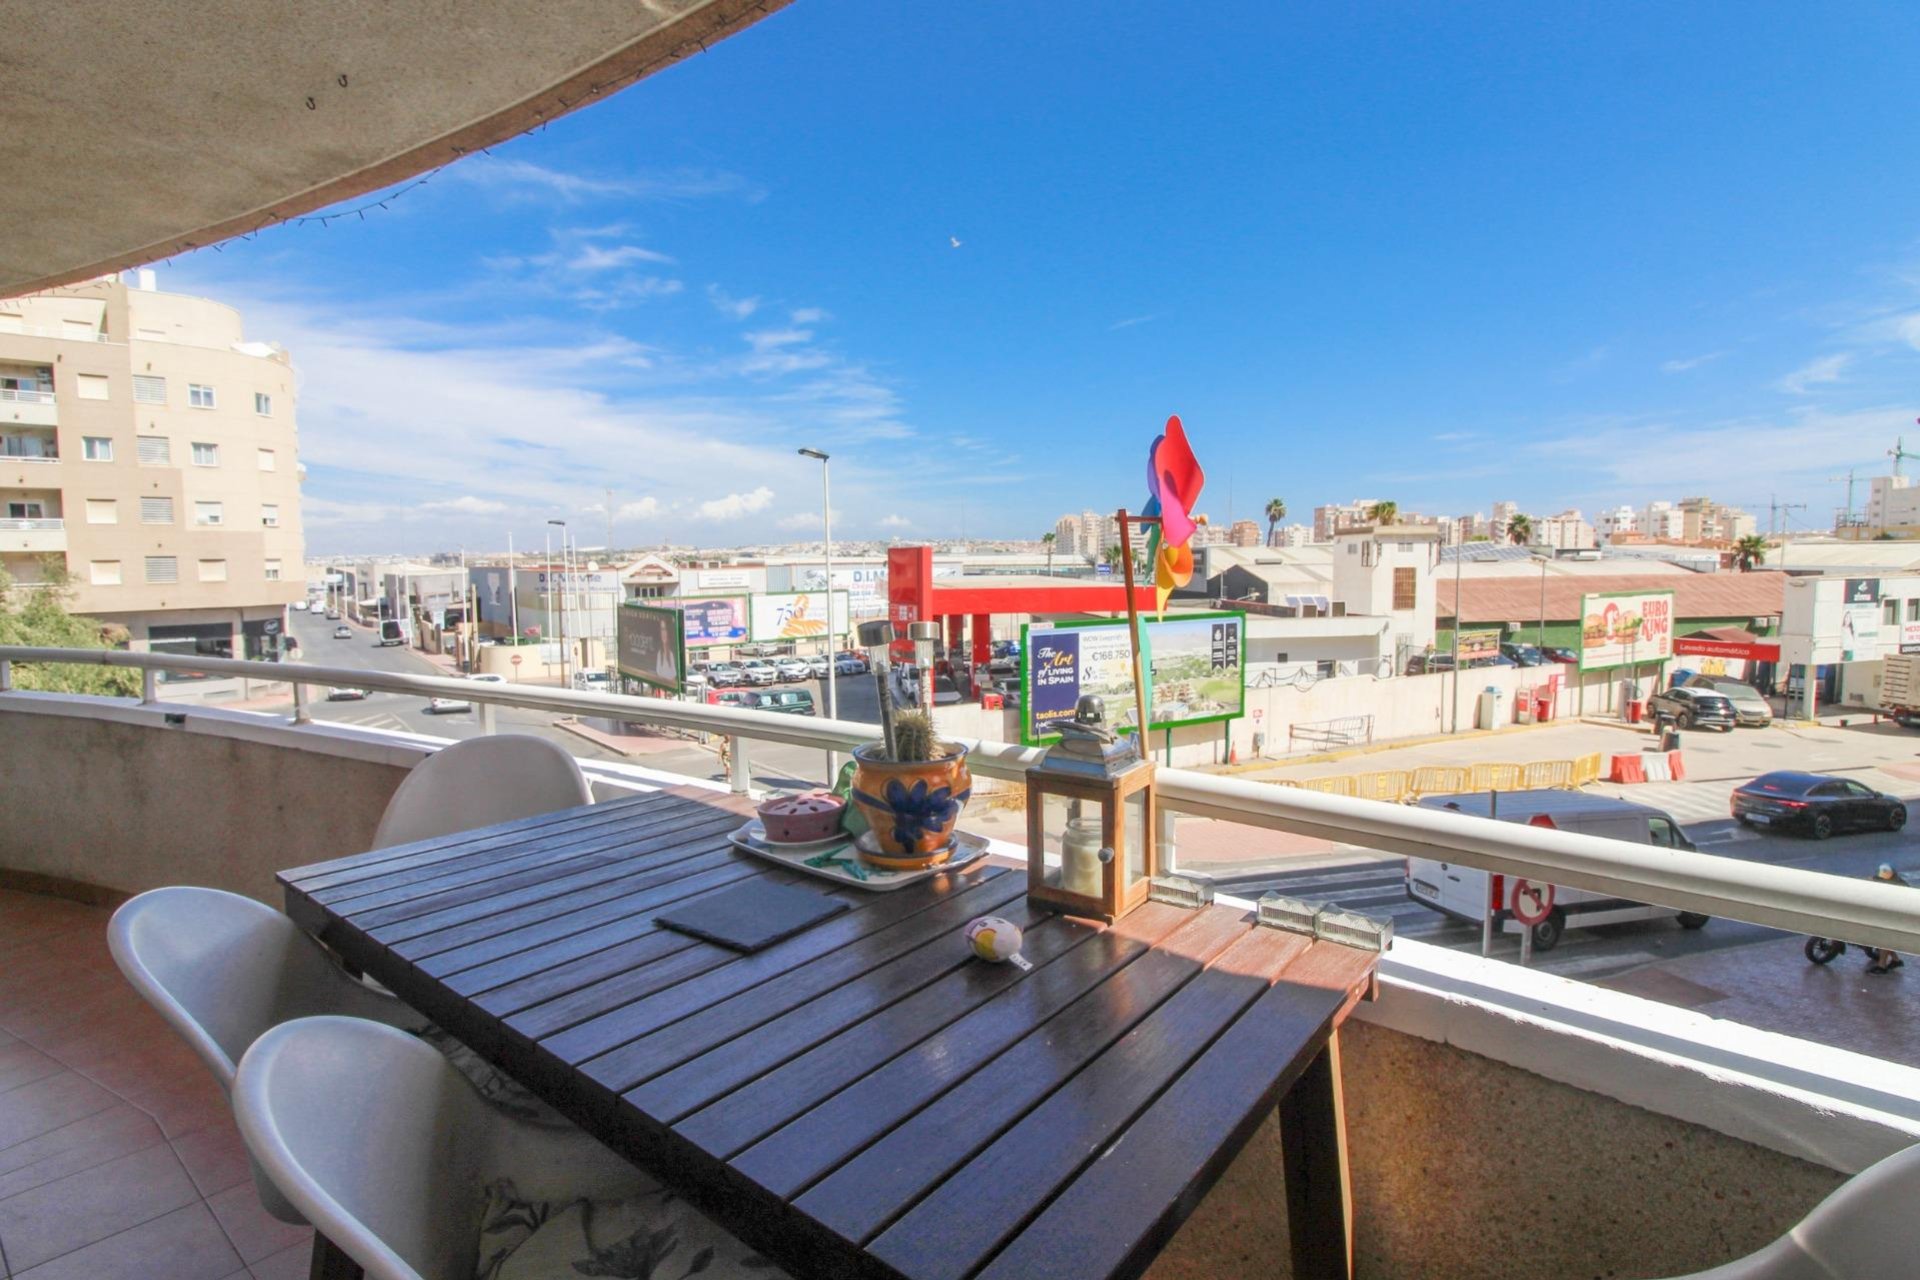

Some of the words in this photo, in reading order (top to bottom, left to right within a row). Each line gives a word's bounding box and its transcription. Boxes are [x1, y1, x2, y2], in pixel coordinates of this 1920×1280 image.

[1642, 600, 1668, 618] EURO
[1642, 617, 1668, 642] KING
[1037, 647, 1057, 659] The
[1680, 643, 1706, 653] Lavado
[1048, 667, 1074, 676] LIVING
[1037, 678, 1047, 686] IN
